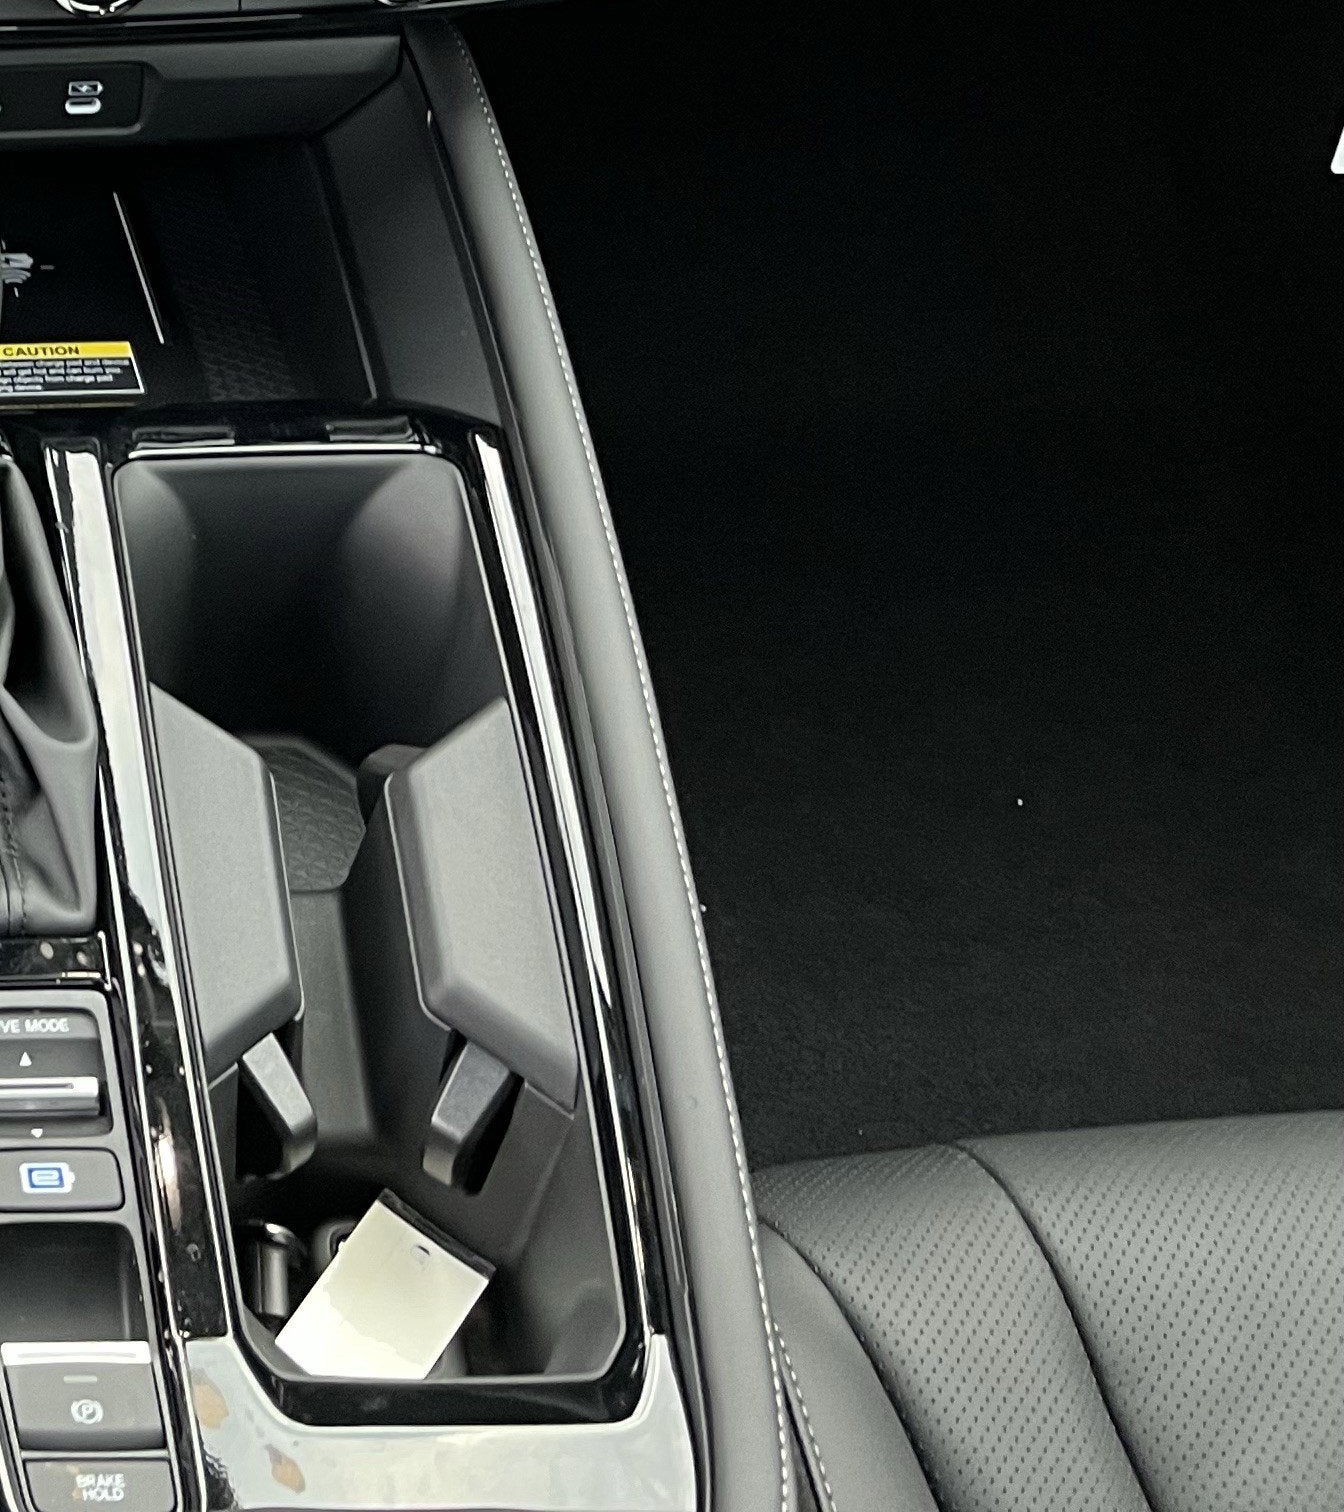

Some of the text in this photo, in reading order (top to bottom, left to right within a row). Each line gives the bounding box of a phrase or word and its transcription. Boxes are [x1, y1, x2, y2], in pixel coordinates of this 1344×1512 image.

[2, 346, 80, 357] CAUTION
[25, 1018, 69, 1033] MODE
[76, 1474, 125, 1488] BRAKE
[82, 1488, 124, 1501] HOLD
